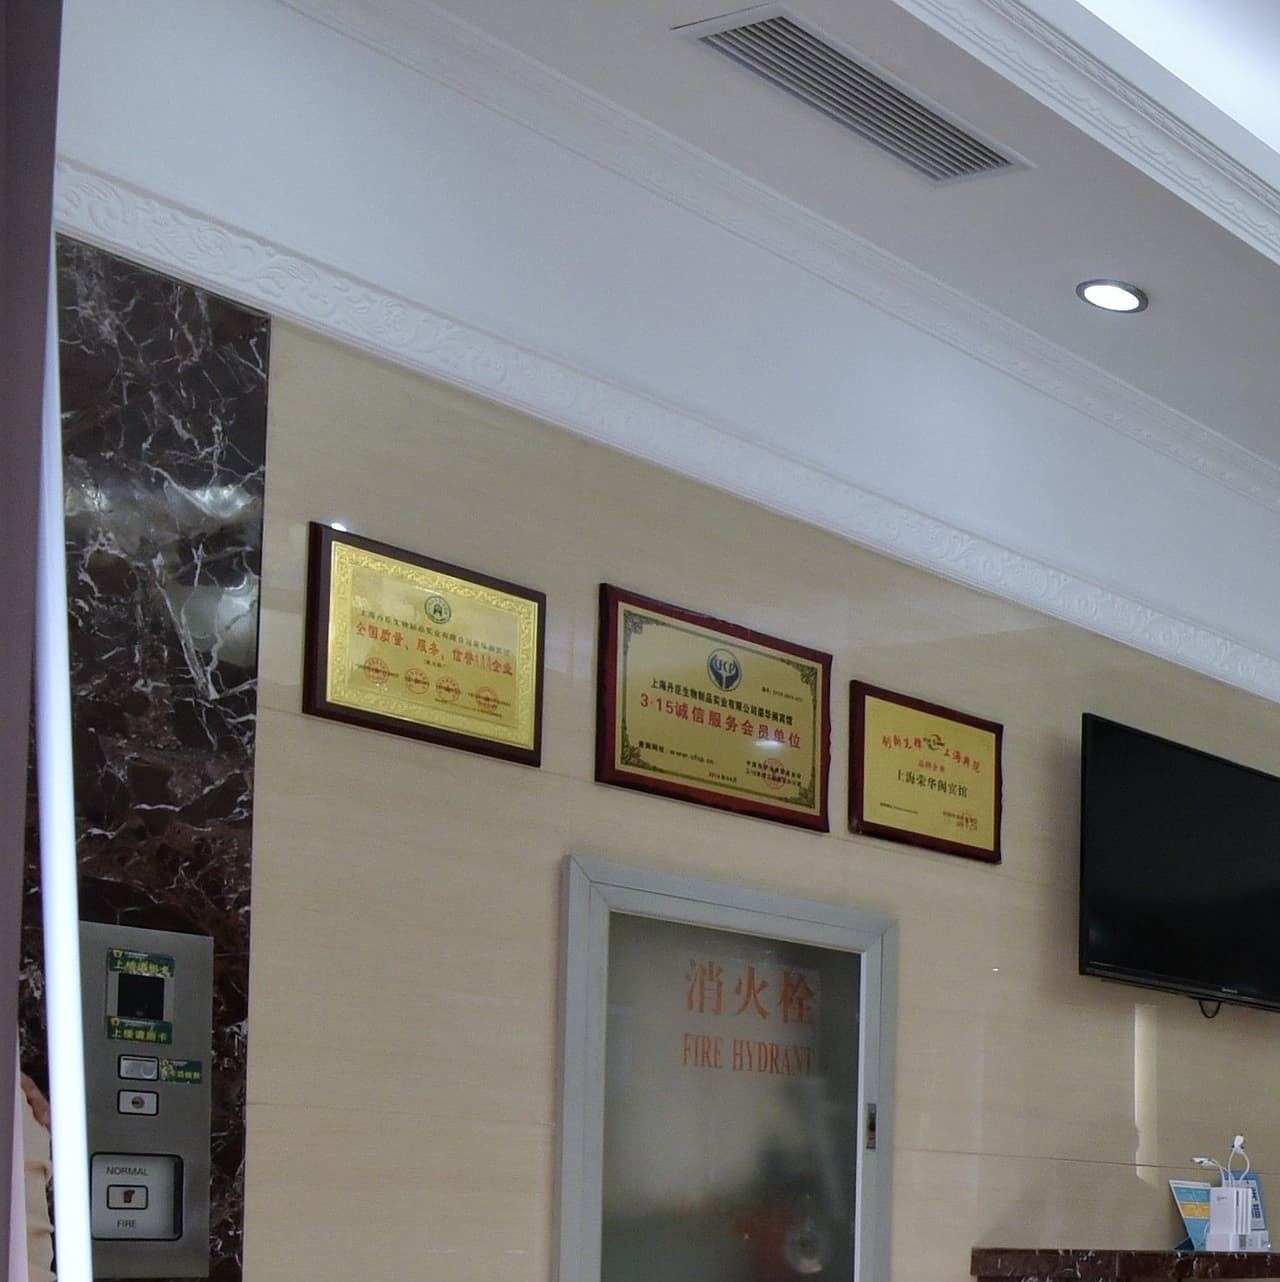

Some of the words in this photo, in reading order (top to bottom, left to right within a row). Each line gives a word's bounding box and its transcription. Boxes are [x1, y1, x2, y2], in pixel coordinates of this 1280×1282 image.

[685, 959, 817, 1025] 消火栓
[683, 1034, 723, 1070] FIRE
[732, 1038, 816, 1076] HYDRANT
[106, 1165, 149, 1177] NORMAL
[116, 1218, 137, 1229] FIRE
